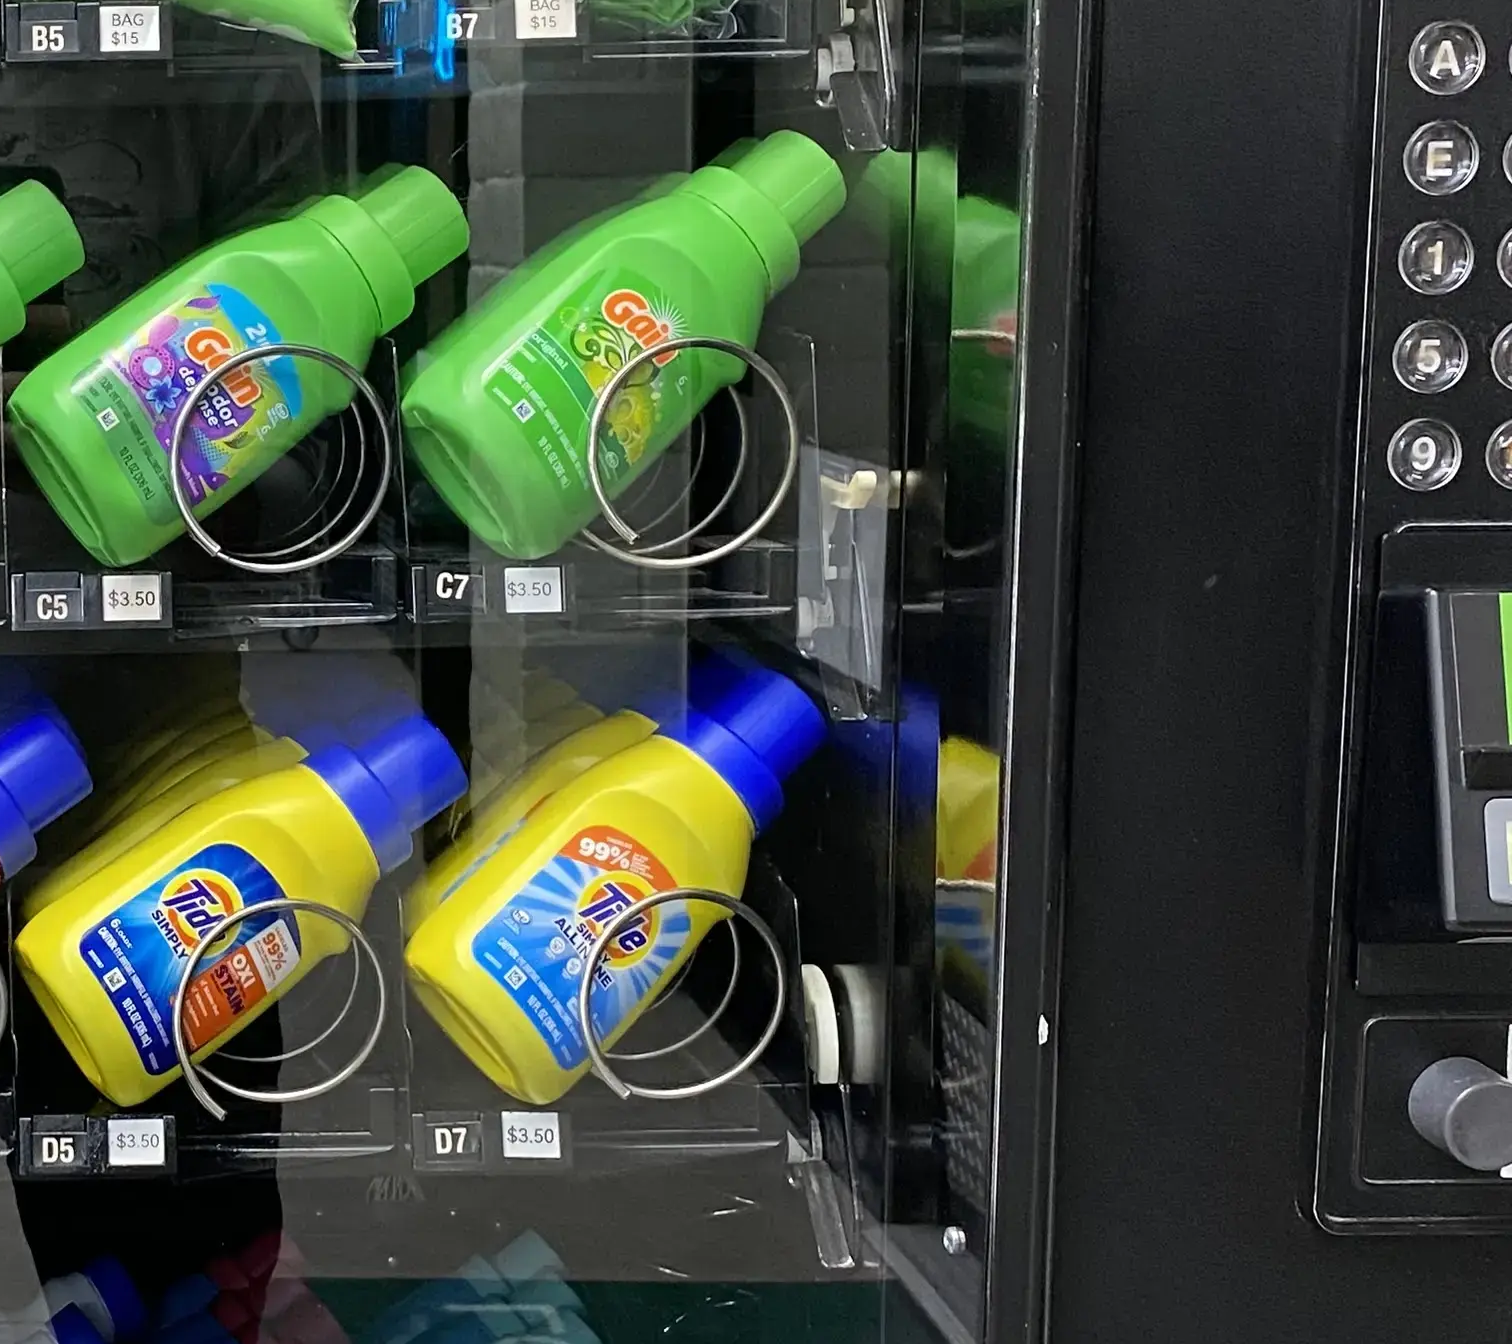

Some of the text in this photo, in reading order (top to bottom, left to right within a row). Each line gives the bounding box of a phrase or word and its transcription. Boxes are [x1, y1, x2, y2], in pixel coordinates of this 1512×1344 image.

[111, 13, 144, 27] BAG
[447, 14, 480, 40] B7
[530, 14, 557, 30] $15
[32, 26, 66, 52] B5
[111, 29, 140, 46] $15
[1430, 39, 1461, 77] A
[1426, 141, 1454, 177] E
[1427, 240, 1444, 276] 1
[245, 320, 268, 342] 2
[602, 290, 679, 367] Gain
[531, 327, 569, 374] original
[1416, 338, 1442, 374] 5
[185, 327, 262, 407] Gain
[1411, 436, 1437, 471] 9
[108, 590, 156, 608] $3.50
[436, 571, 470, 600] C7
[506, 581, 552, 598] $3.50
[36, 594, 68, 620] C5
[578, 836, 630, 871] 99%
[109, 917, 122, 929] 6
[554, 912, 585, 948] ALL
[577, 882, 647, 953] Tide
[151, 909, 190, 960] SIMPLY
[262, 931, 288, 973] 99%
[231, 952, 257, 990] OXI
[214, 963, 247, 1015] STAIN
[120, 996, 138, 1016] 10 FL
[42, 1136, 75, 1163] D5
[116, 1133, 159, 1150] $3.50
[434, 1127, 468, 1155] D7
[506, 1127, 555, 1144] $3.50
